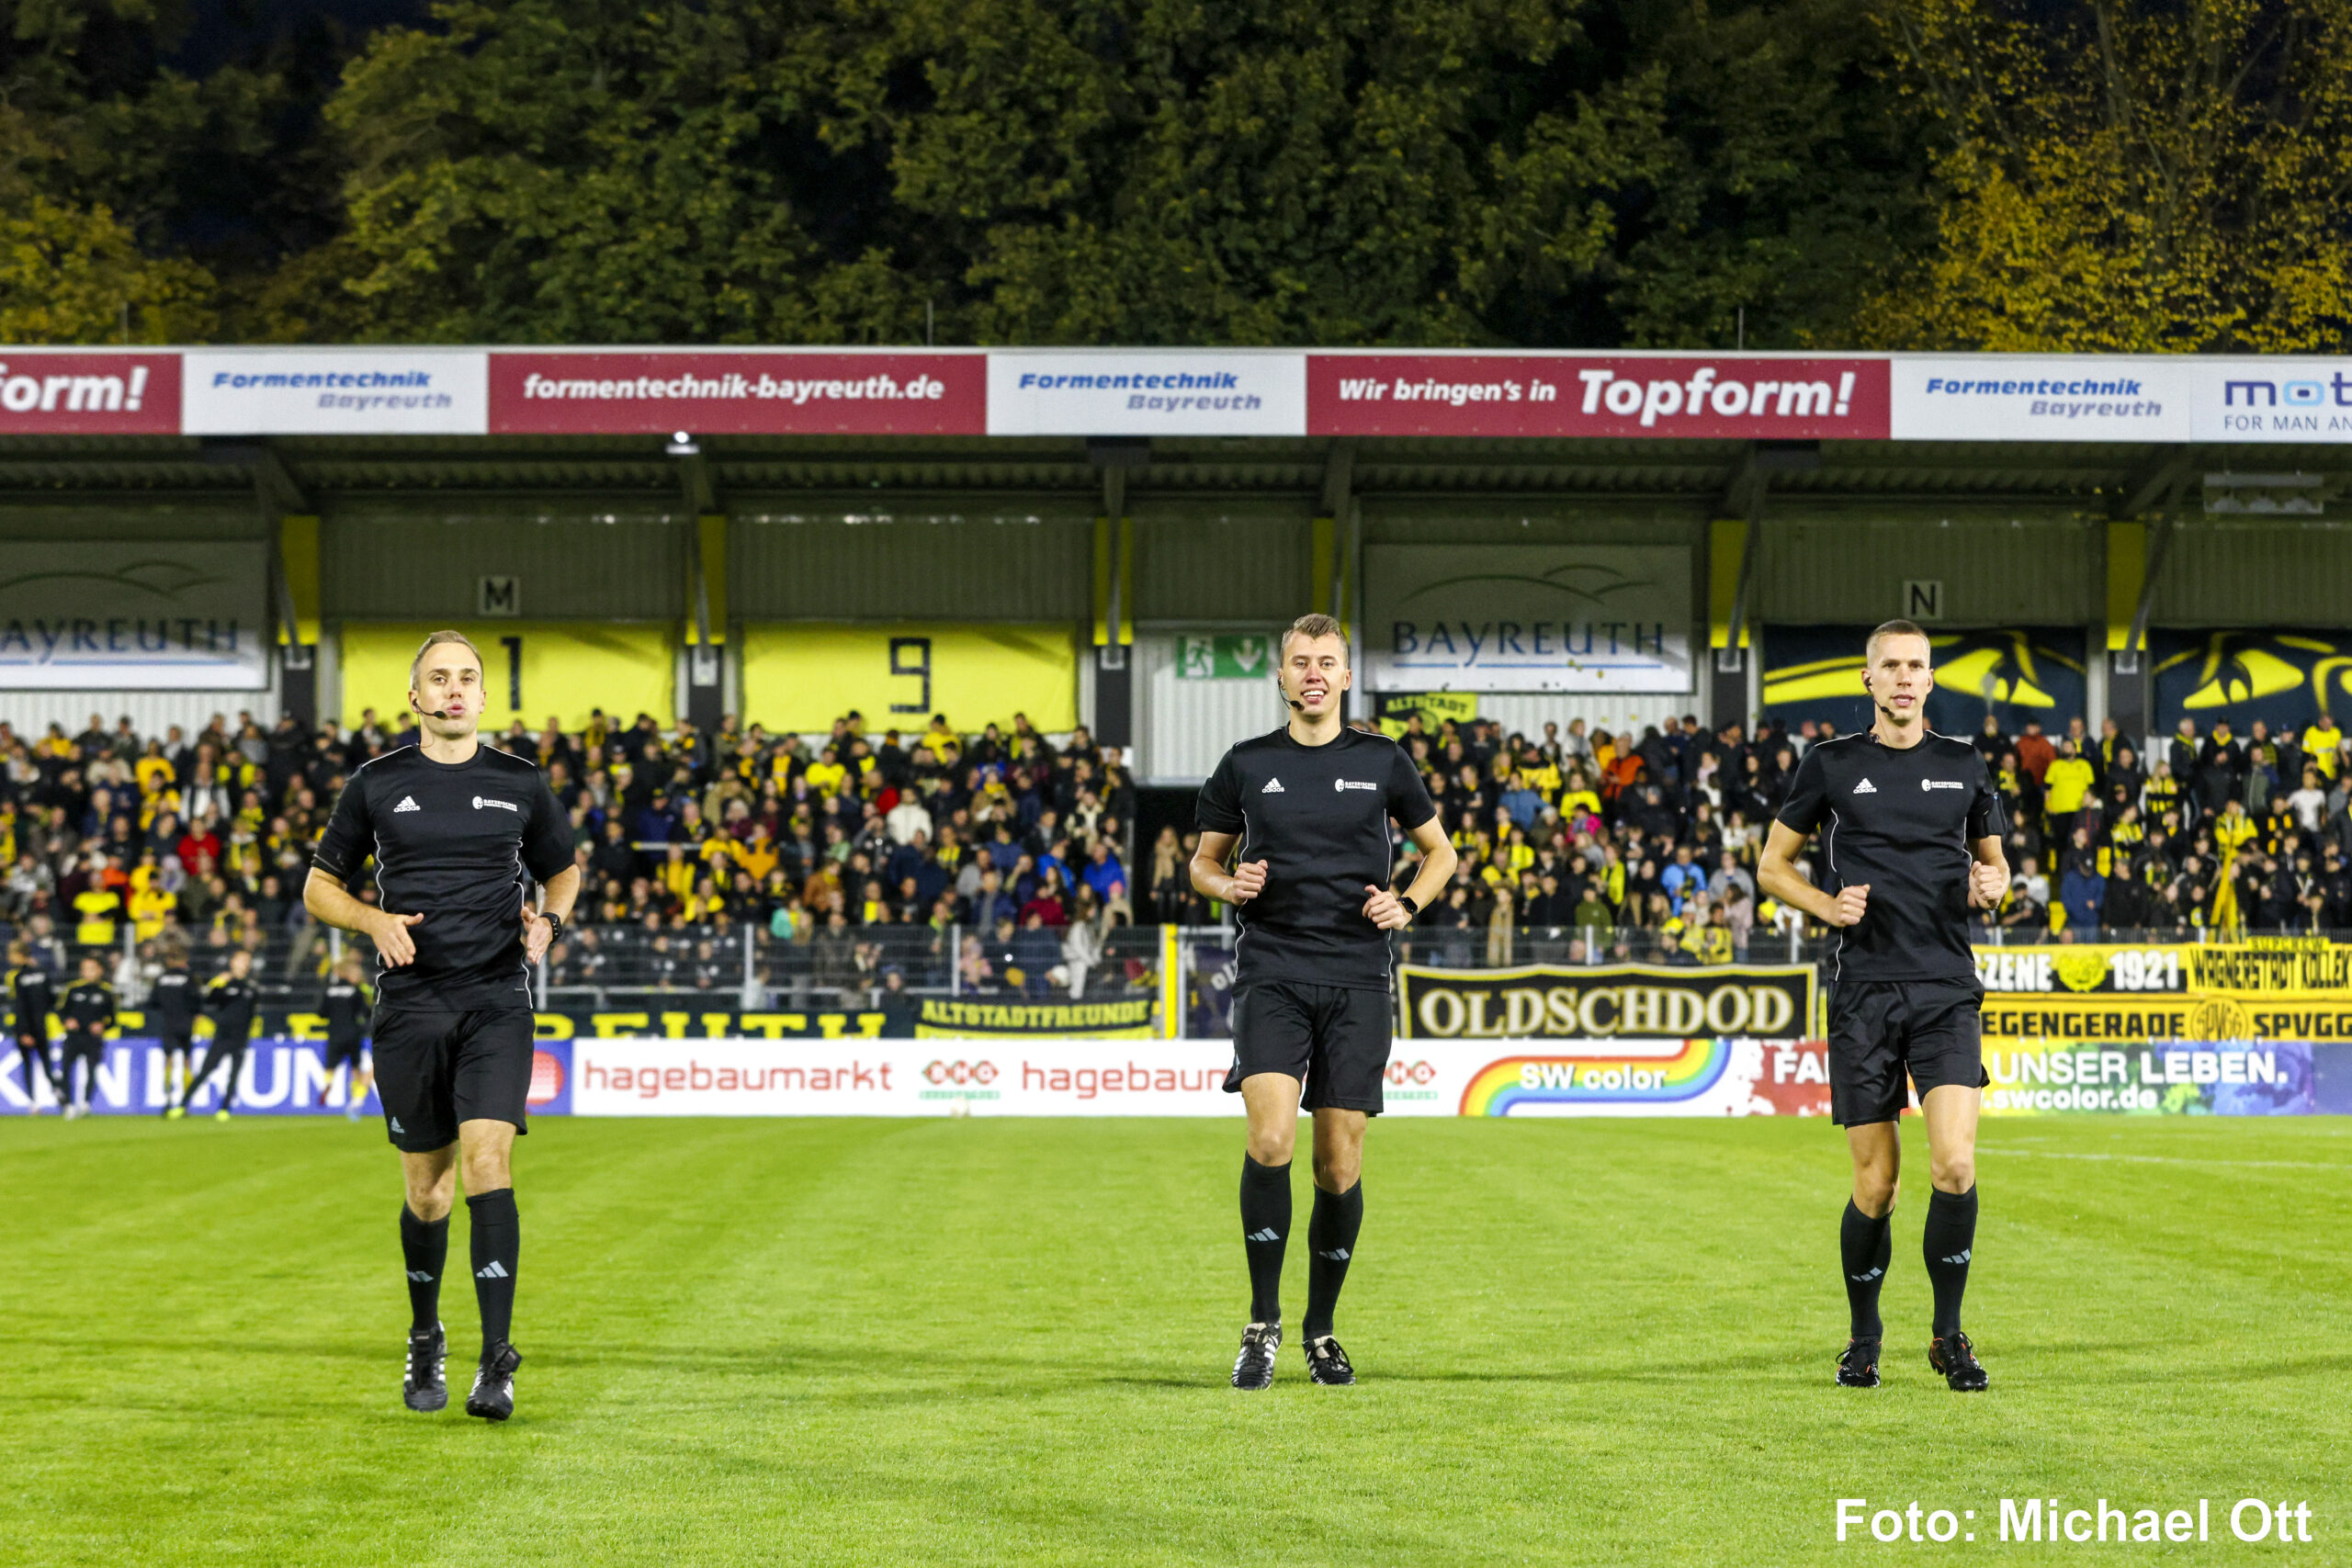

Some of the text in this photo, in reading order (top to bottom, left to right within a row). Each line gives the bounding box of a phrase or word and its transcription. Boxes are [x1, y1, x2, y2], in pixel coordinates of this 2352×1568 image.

[0, 362, 148, 412] orm!
[212, 371, 431, 389] Formentechnik
[524, 373, 944, 404] formentechnik-bayreuth.de
[1019, 372, 1238, 389] Formentechnik
[1927, 378, 2142, 395] Formentechnik
[317, 393, 453, 411] Bayreuth
[1126, 394, 1261, 412] Bayreuth
[1340, 378, 1384, 400] Wir
[1529, 378, 1556, 401] in
[1578, 367, 1856, 427] Topform!
[2030, 400, 2162, 418] Bayreuth
[2224, 415, 2262, 431] FOR
[2273, 415, 2317, 431] MAN
[485, 581, 513, 612] M
[1911, 583, 1936, 616] N
[0, 619, 239, 664] AYREUTH
[1394, 621, 1664, 667] BAYREUTH
[501, 637, 522, 711] 1
[890, 637, 931, 713] 9
[2109, 950, 2179, 990] 1921
[922, 999, 1149, 1027] ALTSTADTFREUNDE
[1419, 985, 1794, 1037] OLDSCHDOD
[1981, 1011, 2186, 1037] EGENGERADE
[2254, 1012, 2352, 1037] SPVGG
[584, 1060, 893, 1099] hagebaumarkt
[1023, 1061, 1229, 1100] hagebau
[1521, 1064, 1667, 1090] SW color
[1773, 1051, 2288, 1085] FA UNSER LEBEN.
[1980, 1083, 2158, 1110] .swcolor.de
